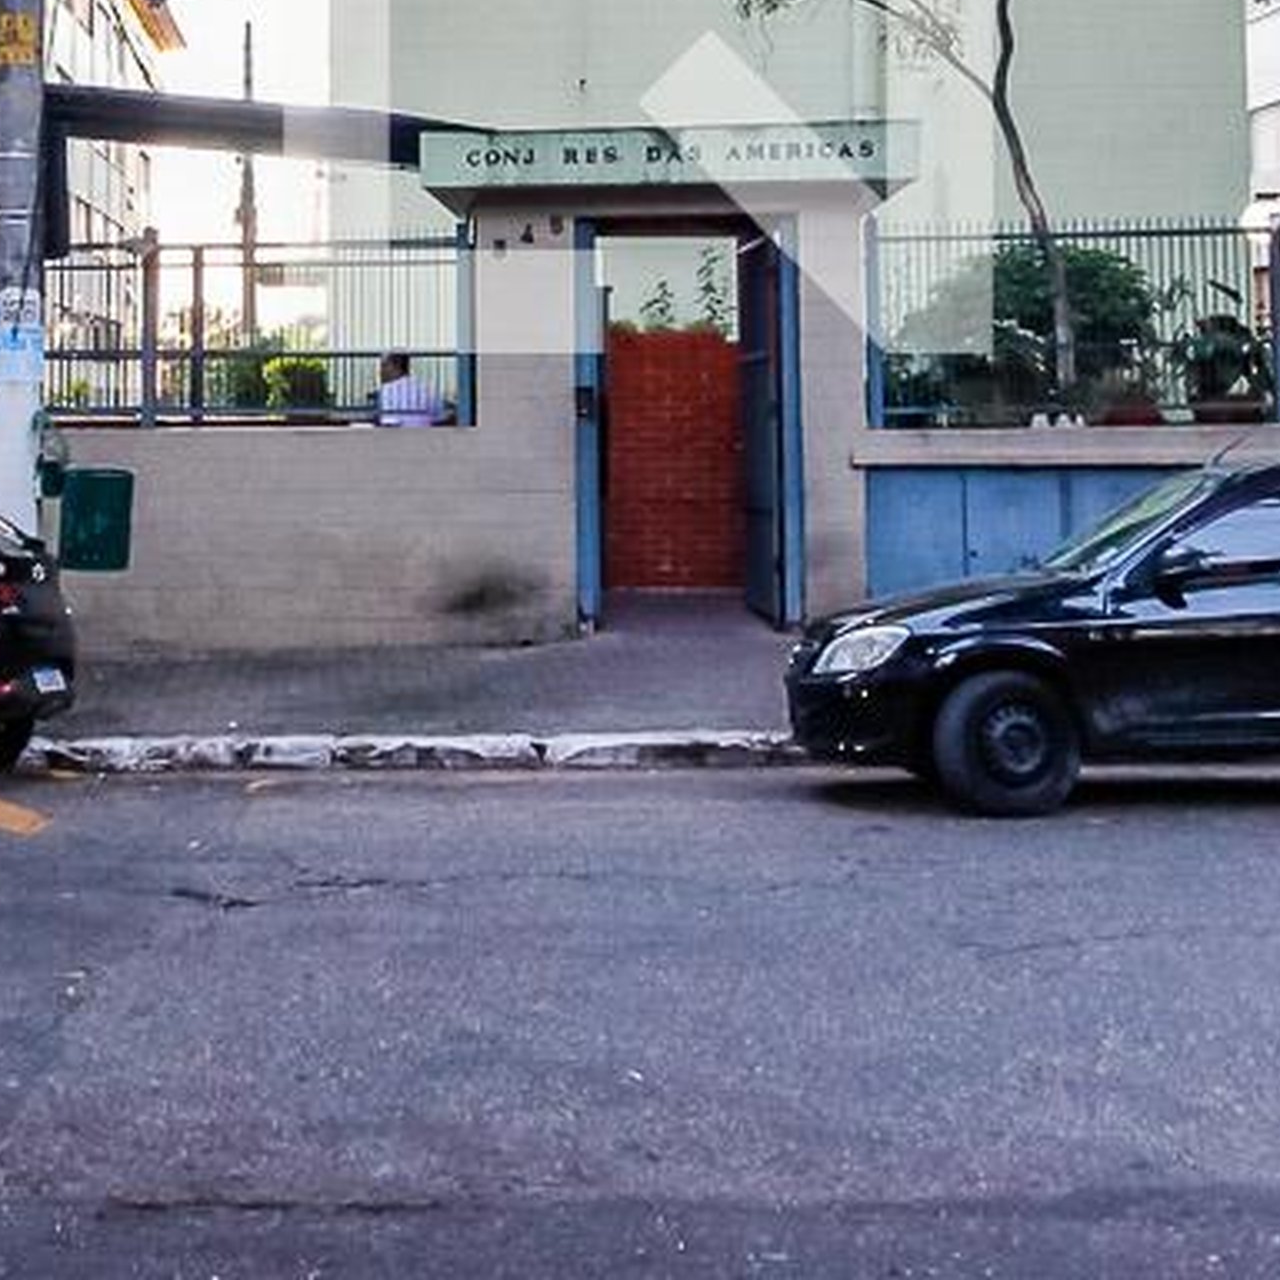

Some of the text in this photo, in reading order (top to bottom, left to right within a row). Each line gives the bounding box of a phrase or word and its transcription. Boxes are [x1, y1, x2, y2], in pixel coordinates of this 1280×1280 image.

[466, 139, 875, 168] CONJ RES DAS AMERICAS
